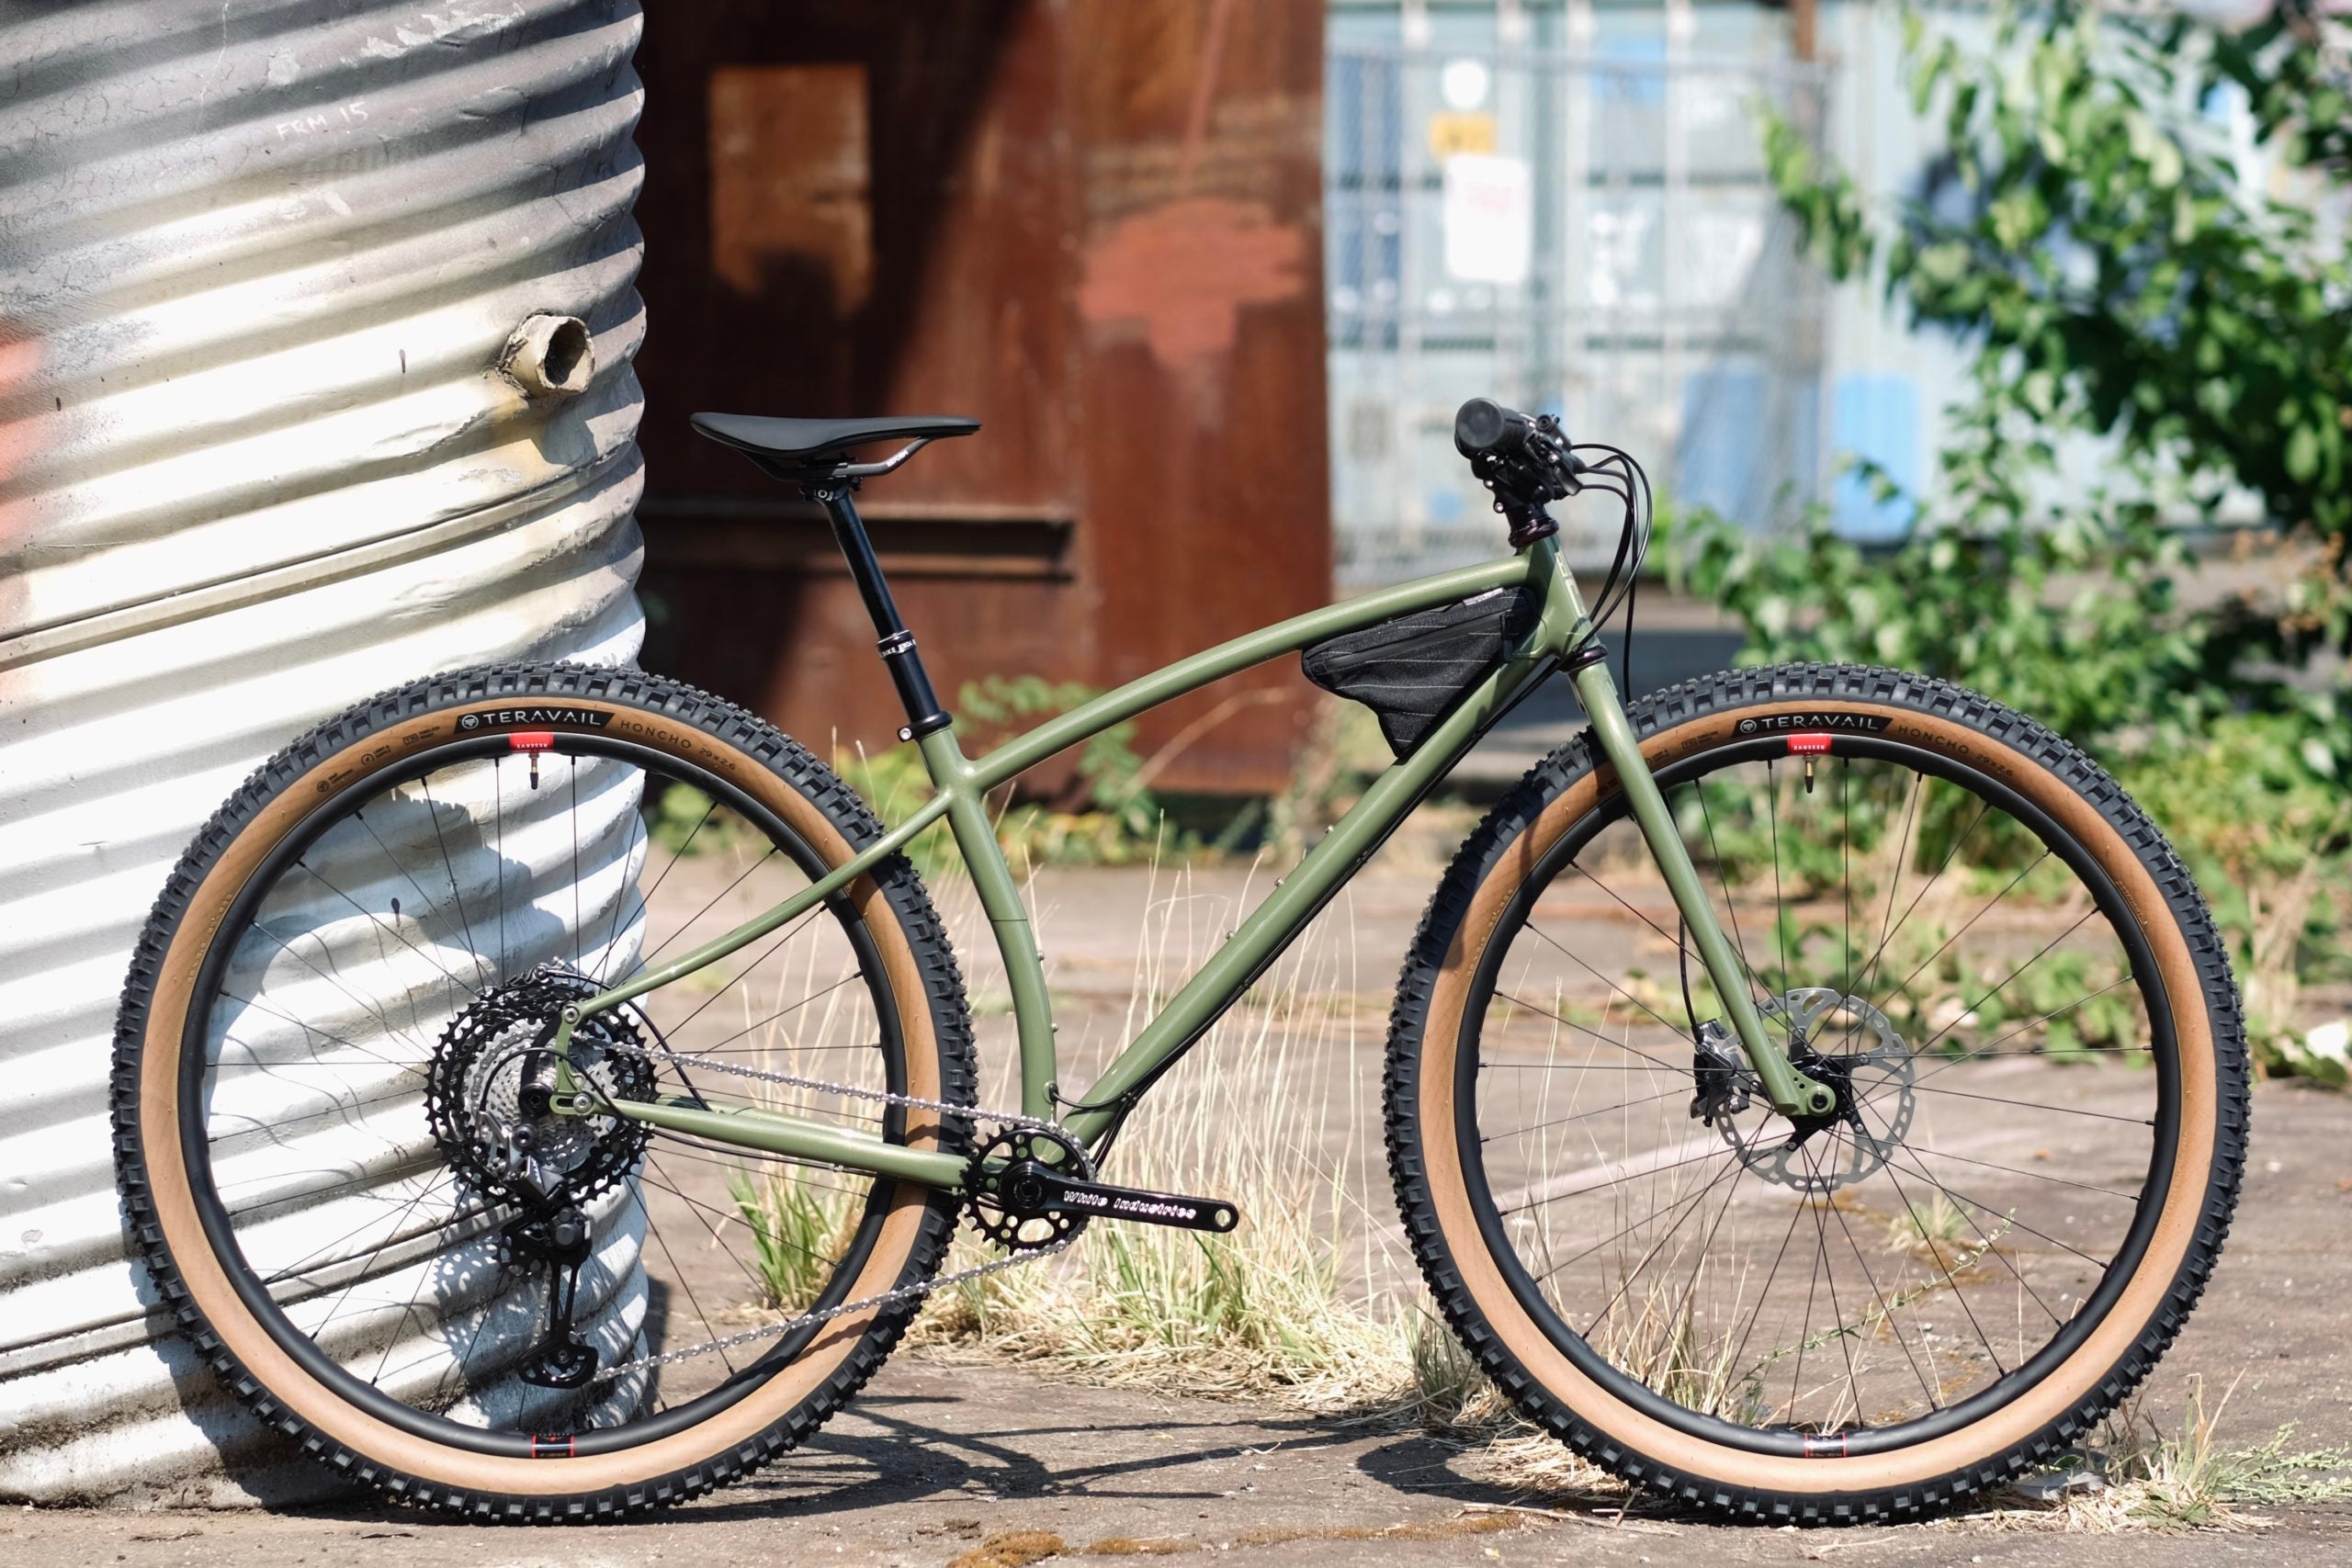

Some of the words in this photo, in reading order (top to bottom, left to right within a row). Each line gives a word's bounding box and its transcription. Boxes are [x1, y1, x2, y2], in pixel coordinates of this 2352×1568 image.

[276, 115, 328, 141] FRM
[339, 101, 368, 123] 15
[483, 710, 602, 726] TERAVAIL
[620, 720, 692, 749] HONCHO
[1761, 715, 1879, 730] TERAVAIL
[1898, 725, 1970, 753] HONCHO
[1063, 1190, 1109, 1207] White
[1114, 1197, 1197, 1220] Industries
